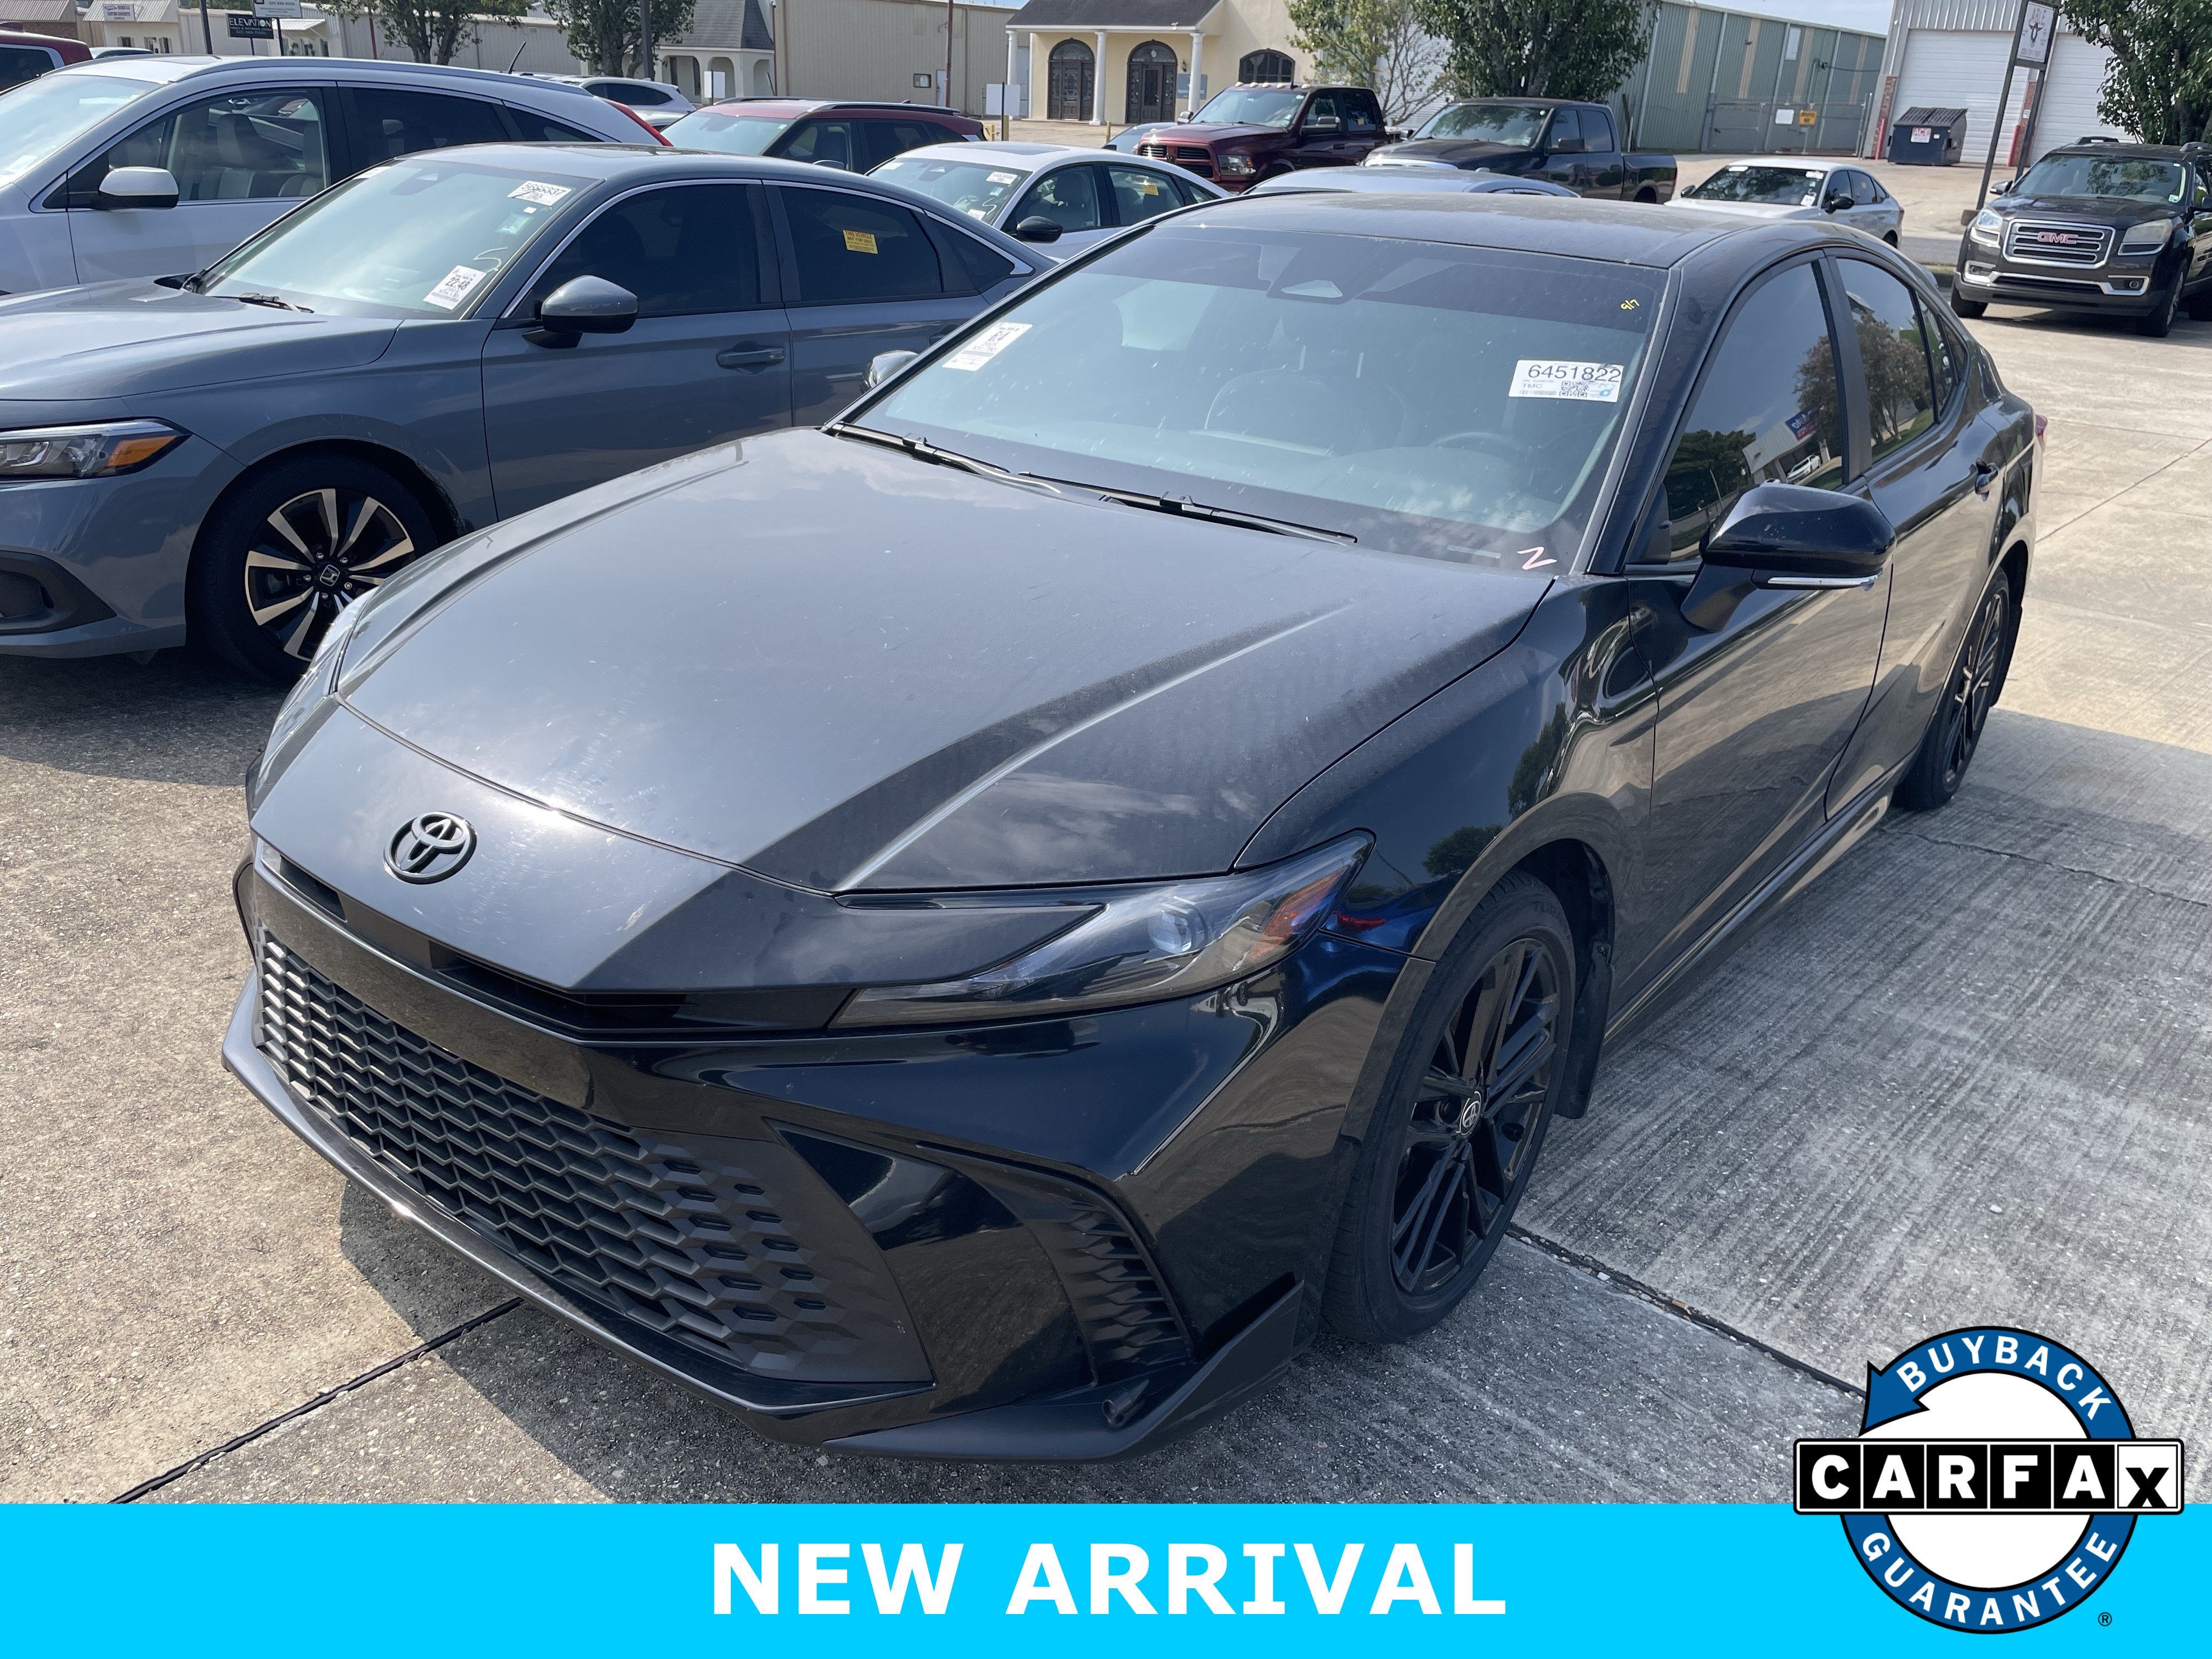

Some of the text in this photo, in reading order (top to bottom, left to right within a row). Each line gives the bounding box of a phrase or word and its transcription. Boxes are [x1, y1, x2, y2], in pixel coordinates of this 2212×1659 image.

[228, 17, 272, 27] ELEVATION
[2037, 231, 2079, 245] GMC
[1528, 364, 1621, 383] 6451822
